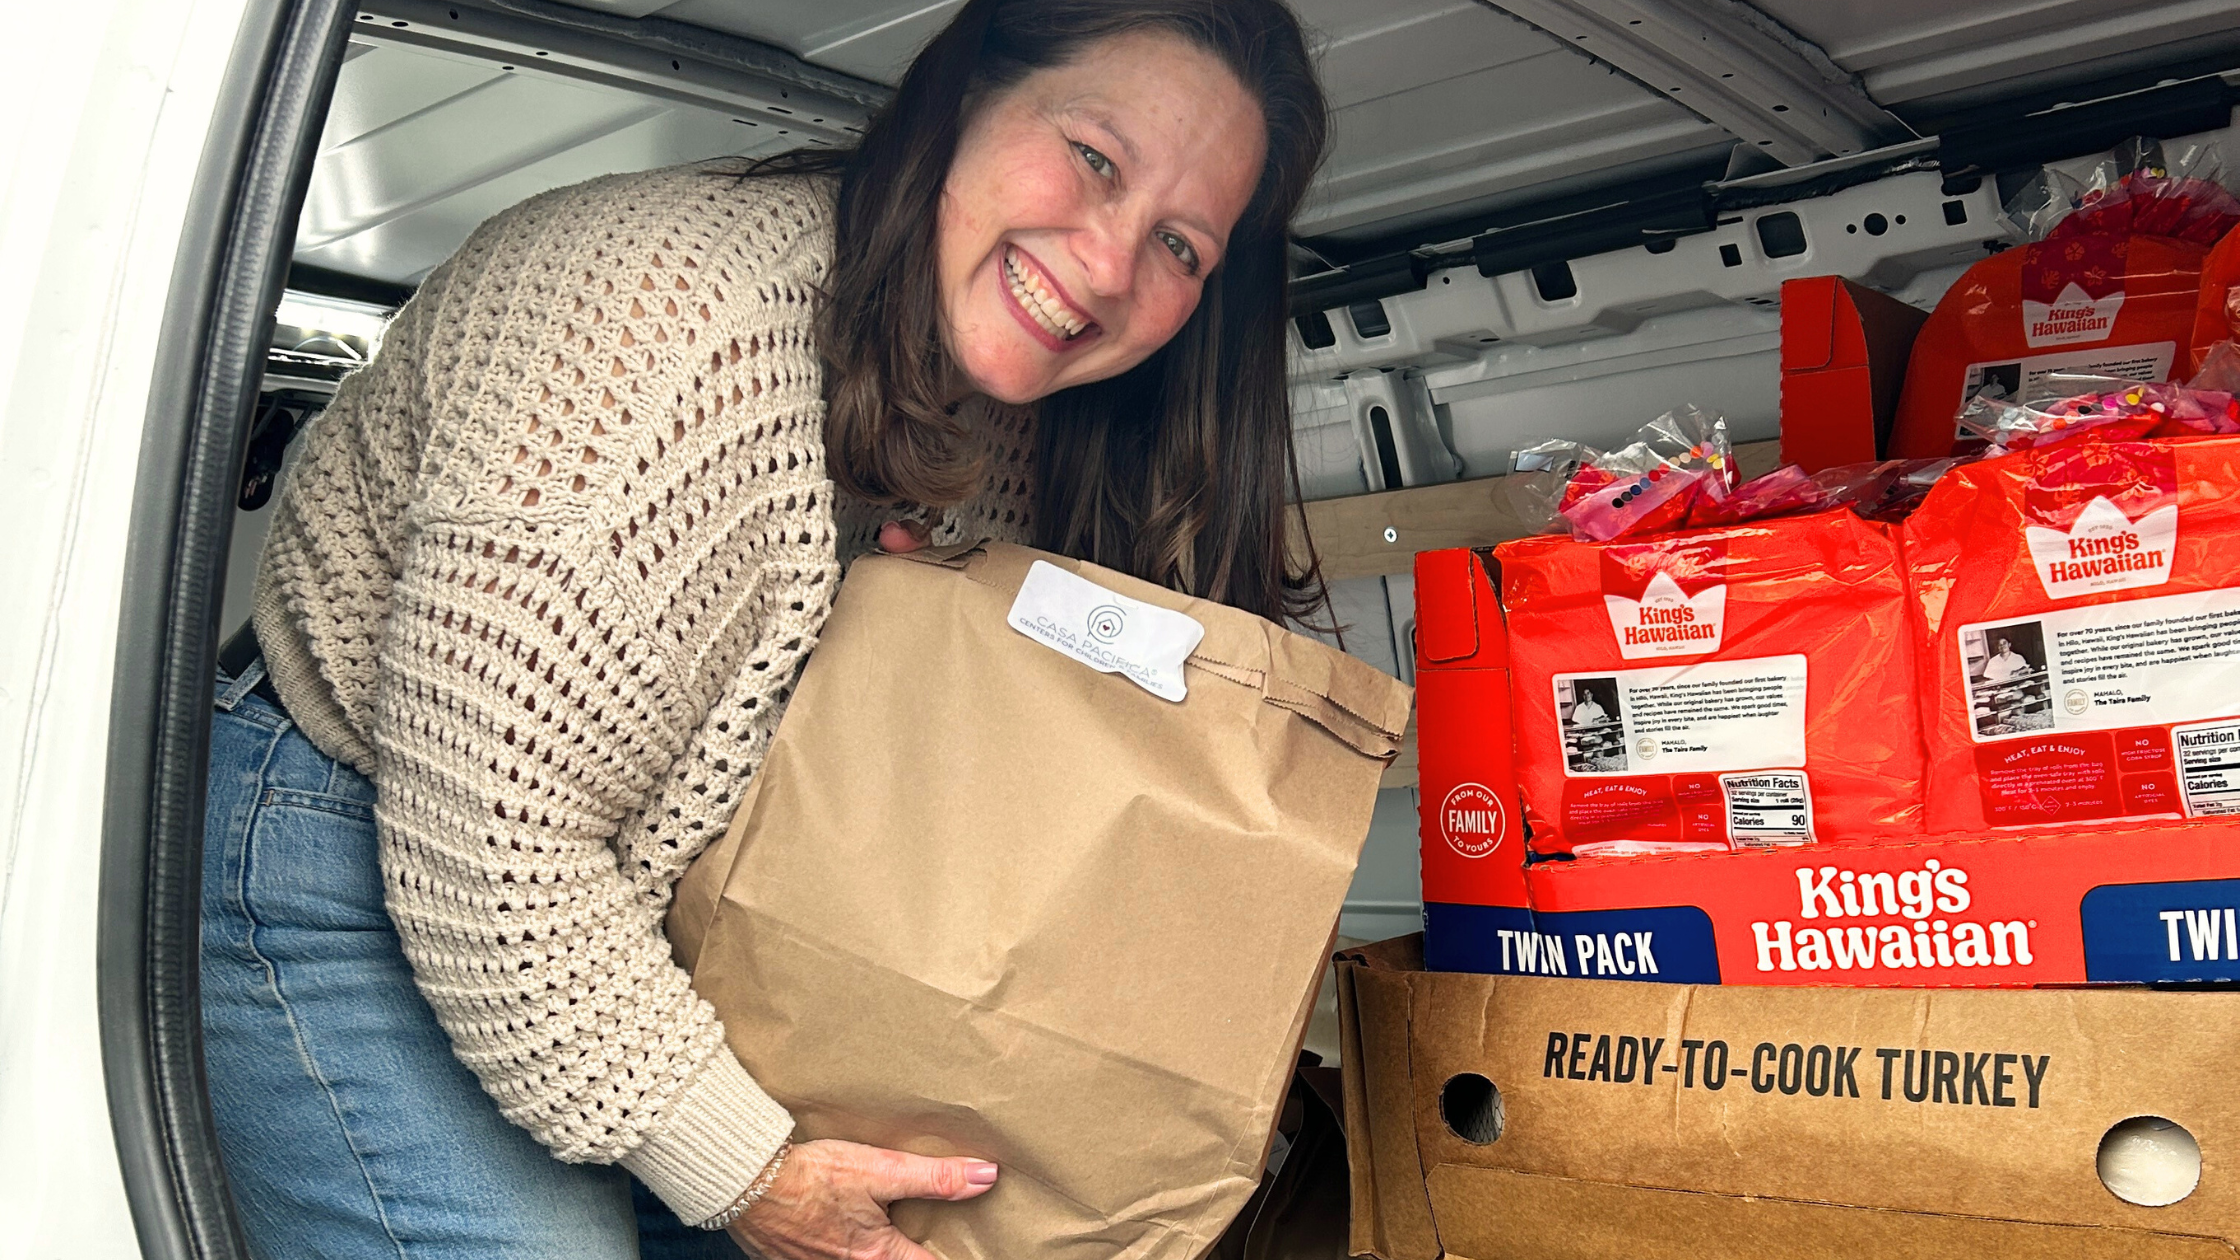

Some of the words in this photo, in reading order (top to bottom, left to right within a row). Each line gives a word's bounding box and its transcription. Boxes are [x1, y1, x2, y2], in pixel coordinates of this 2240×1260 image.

[2048, 306, 2095, 321] King's
[2032, 317, 2107, 337] Hawaiian
[2068, 530, 2139, 559] King's
[1639, 604, 1694, 625] King's
[2144, 619, 2163, 627] family
[2165, 616, 2194, 624] founded
[1037, 616, 1076, 643] CASA
[2126, 631, 2155, 639] Hawaiian
[2188, 623, 2217, 631] bringing
[1020, 618, 1055, 640] CENTERS
[1057, 638, 1074, 649] FOR
[1076, 648, 1116, 668] CHILDREN
[2060, 649, 2088, 657] together.
[2121, 641, 2144, 649] original
[2212, 640, 2231, 648] good
[2127, 694, 2151, 703] Family
[2180, 732, 2234, 746] Nutrition
[2004, 749, 2030, 763] HEAT,
[2031, 745, 2047, 754] EAT
[2058, 745, 2086, 756] ENJOY
[2192, 748, 2216, 756] servings
[1727, 778, 1770, 788] Nutrition
[1773, 777, 1799, 788] Facts
[2188, 779, 2228, 790] Calories
[1451, 790, 1474, 806] FROM
[1476, 791, 1494, 807] OUR
[1584, 787, 1603, 798] HEAT,
[1625, 786, 1647, 796] ENJOY
[1449, 810, 1497, 834] FAMILY
[1733, 817, 1764, 825] Calories
[1792, 815, 1805, 826] 90
[1454, 836, 1464, 847] TO
[1466, 838, 1493, 852] YOURS
[1796, 859, 1971, 919] King's
[2160, 909, 2238, 961] TWI
[1497, 930, 1568, 975] TWIN
[1575, 932, 1659, 975] PACK
[1544, 1032, 1861, 1098] READY-TO-COOK
[1876, 1048, 2051, 1108] TURKEY
